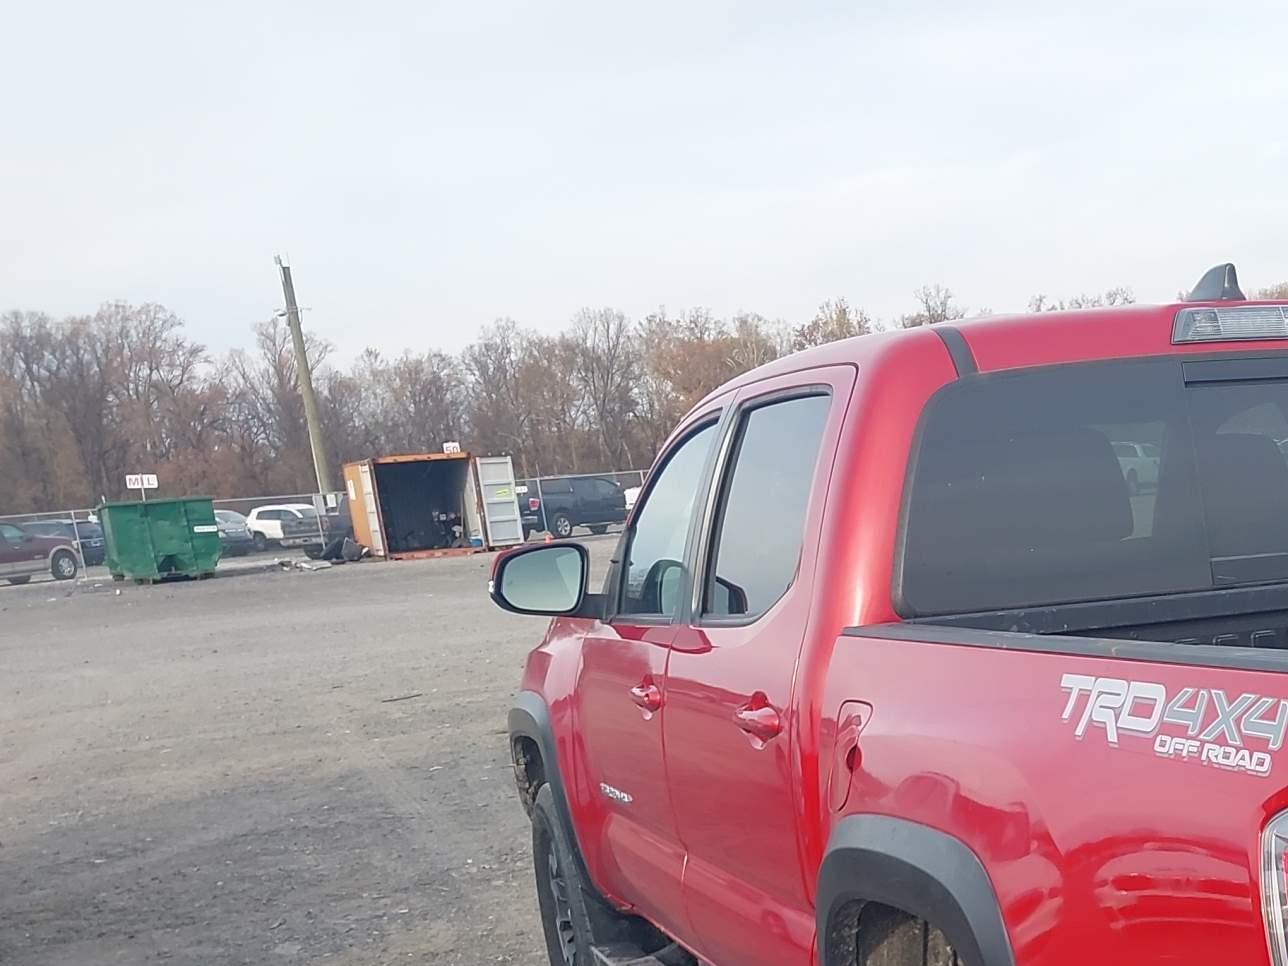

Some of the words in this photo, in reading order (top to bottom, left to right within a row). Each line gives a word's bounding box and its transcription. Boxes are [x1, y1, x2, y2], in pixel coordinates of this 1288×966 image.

[1060, 673, 1167, 746] TRD
[1153, 734, 1201, 760] OFF
[1201, 743, 1272, 776] ROAD
